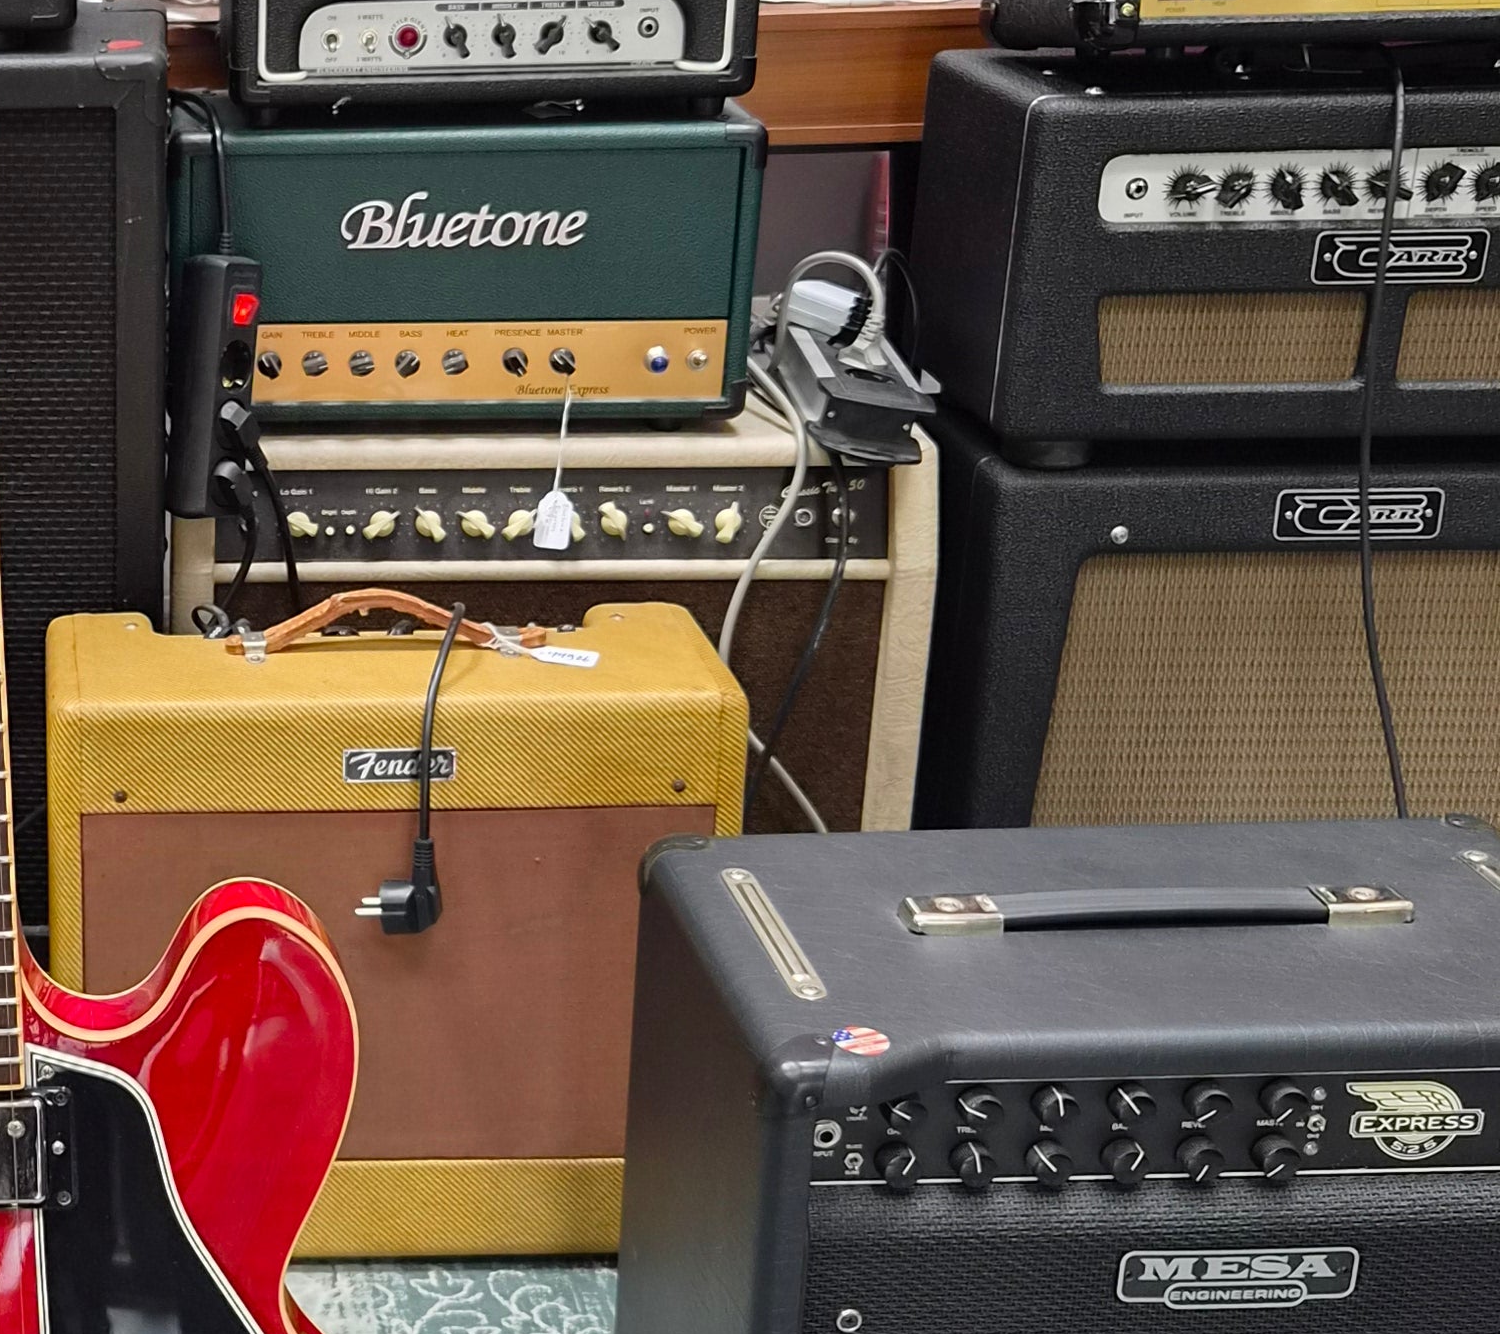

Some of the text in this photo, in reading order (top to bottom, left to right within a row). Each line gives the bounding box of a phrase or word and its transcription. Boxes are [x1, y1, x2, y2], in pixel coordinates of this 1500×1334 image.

[340, 190, 588, 249] Bluetone
[261, 327, 717, 339] GAIN TREBLE MIDDLE BASS HEAT PRESENCE MASTER POWER
[516, 384, 564, 396] Bluetone
[848, 478, 866, 492] 50
[1358, 1115, 1476, 1133] EXPRESS
[1138, 1255, 1336, 1281] MESA
[1168, 1288, 1300, 1302] ENGINEERING
